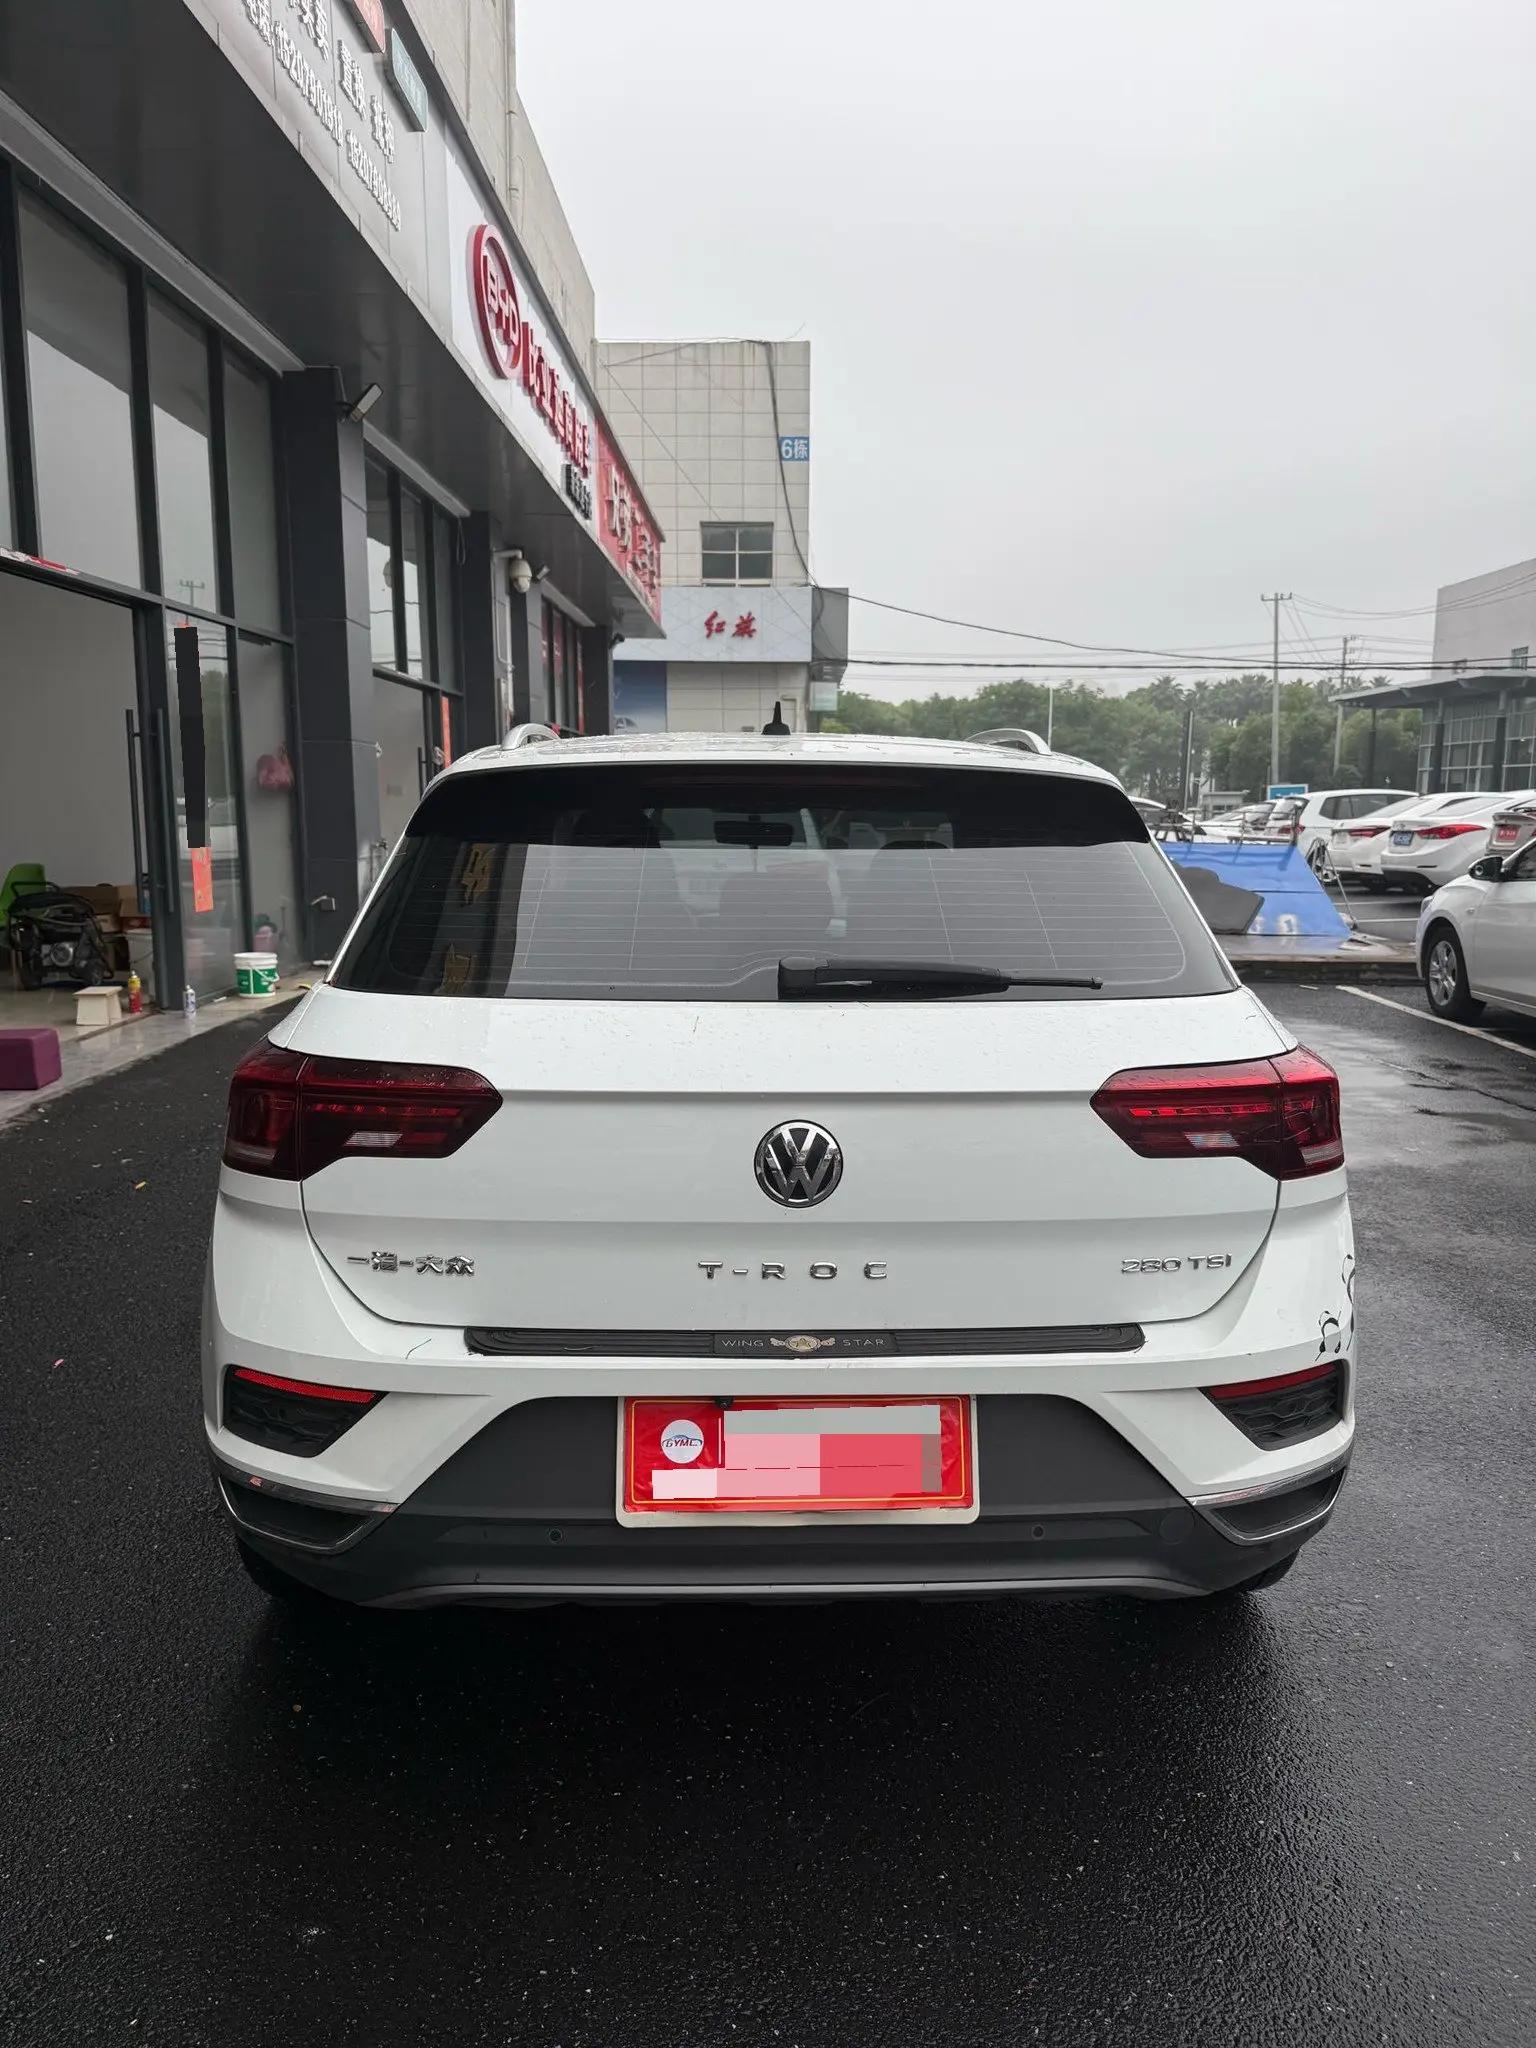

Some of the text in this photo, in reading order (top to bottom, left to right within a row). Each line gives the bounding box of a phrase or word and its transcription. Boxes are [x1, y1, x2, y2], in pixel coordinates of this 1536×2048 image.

[782, 438, 809, 460] 6栋
[704, 611, 757, 639] 红旗
[1121, 1253, 1233, 1275] 280 TSI
[721, 1338, 887, 1347] WING STAR
